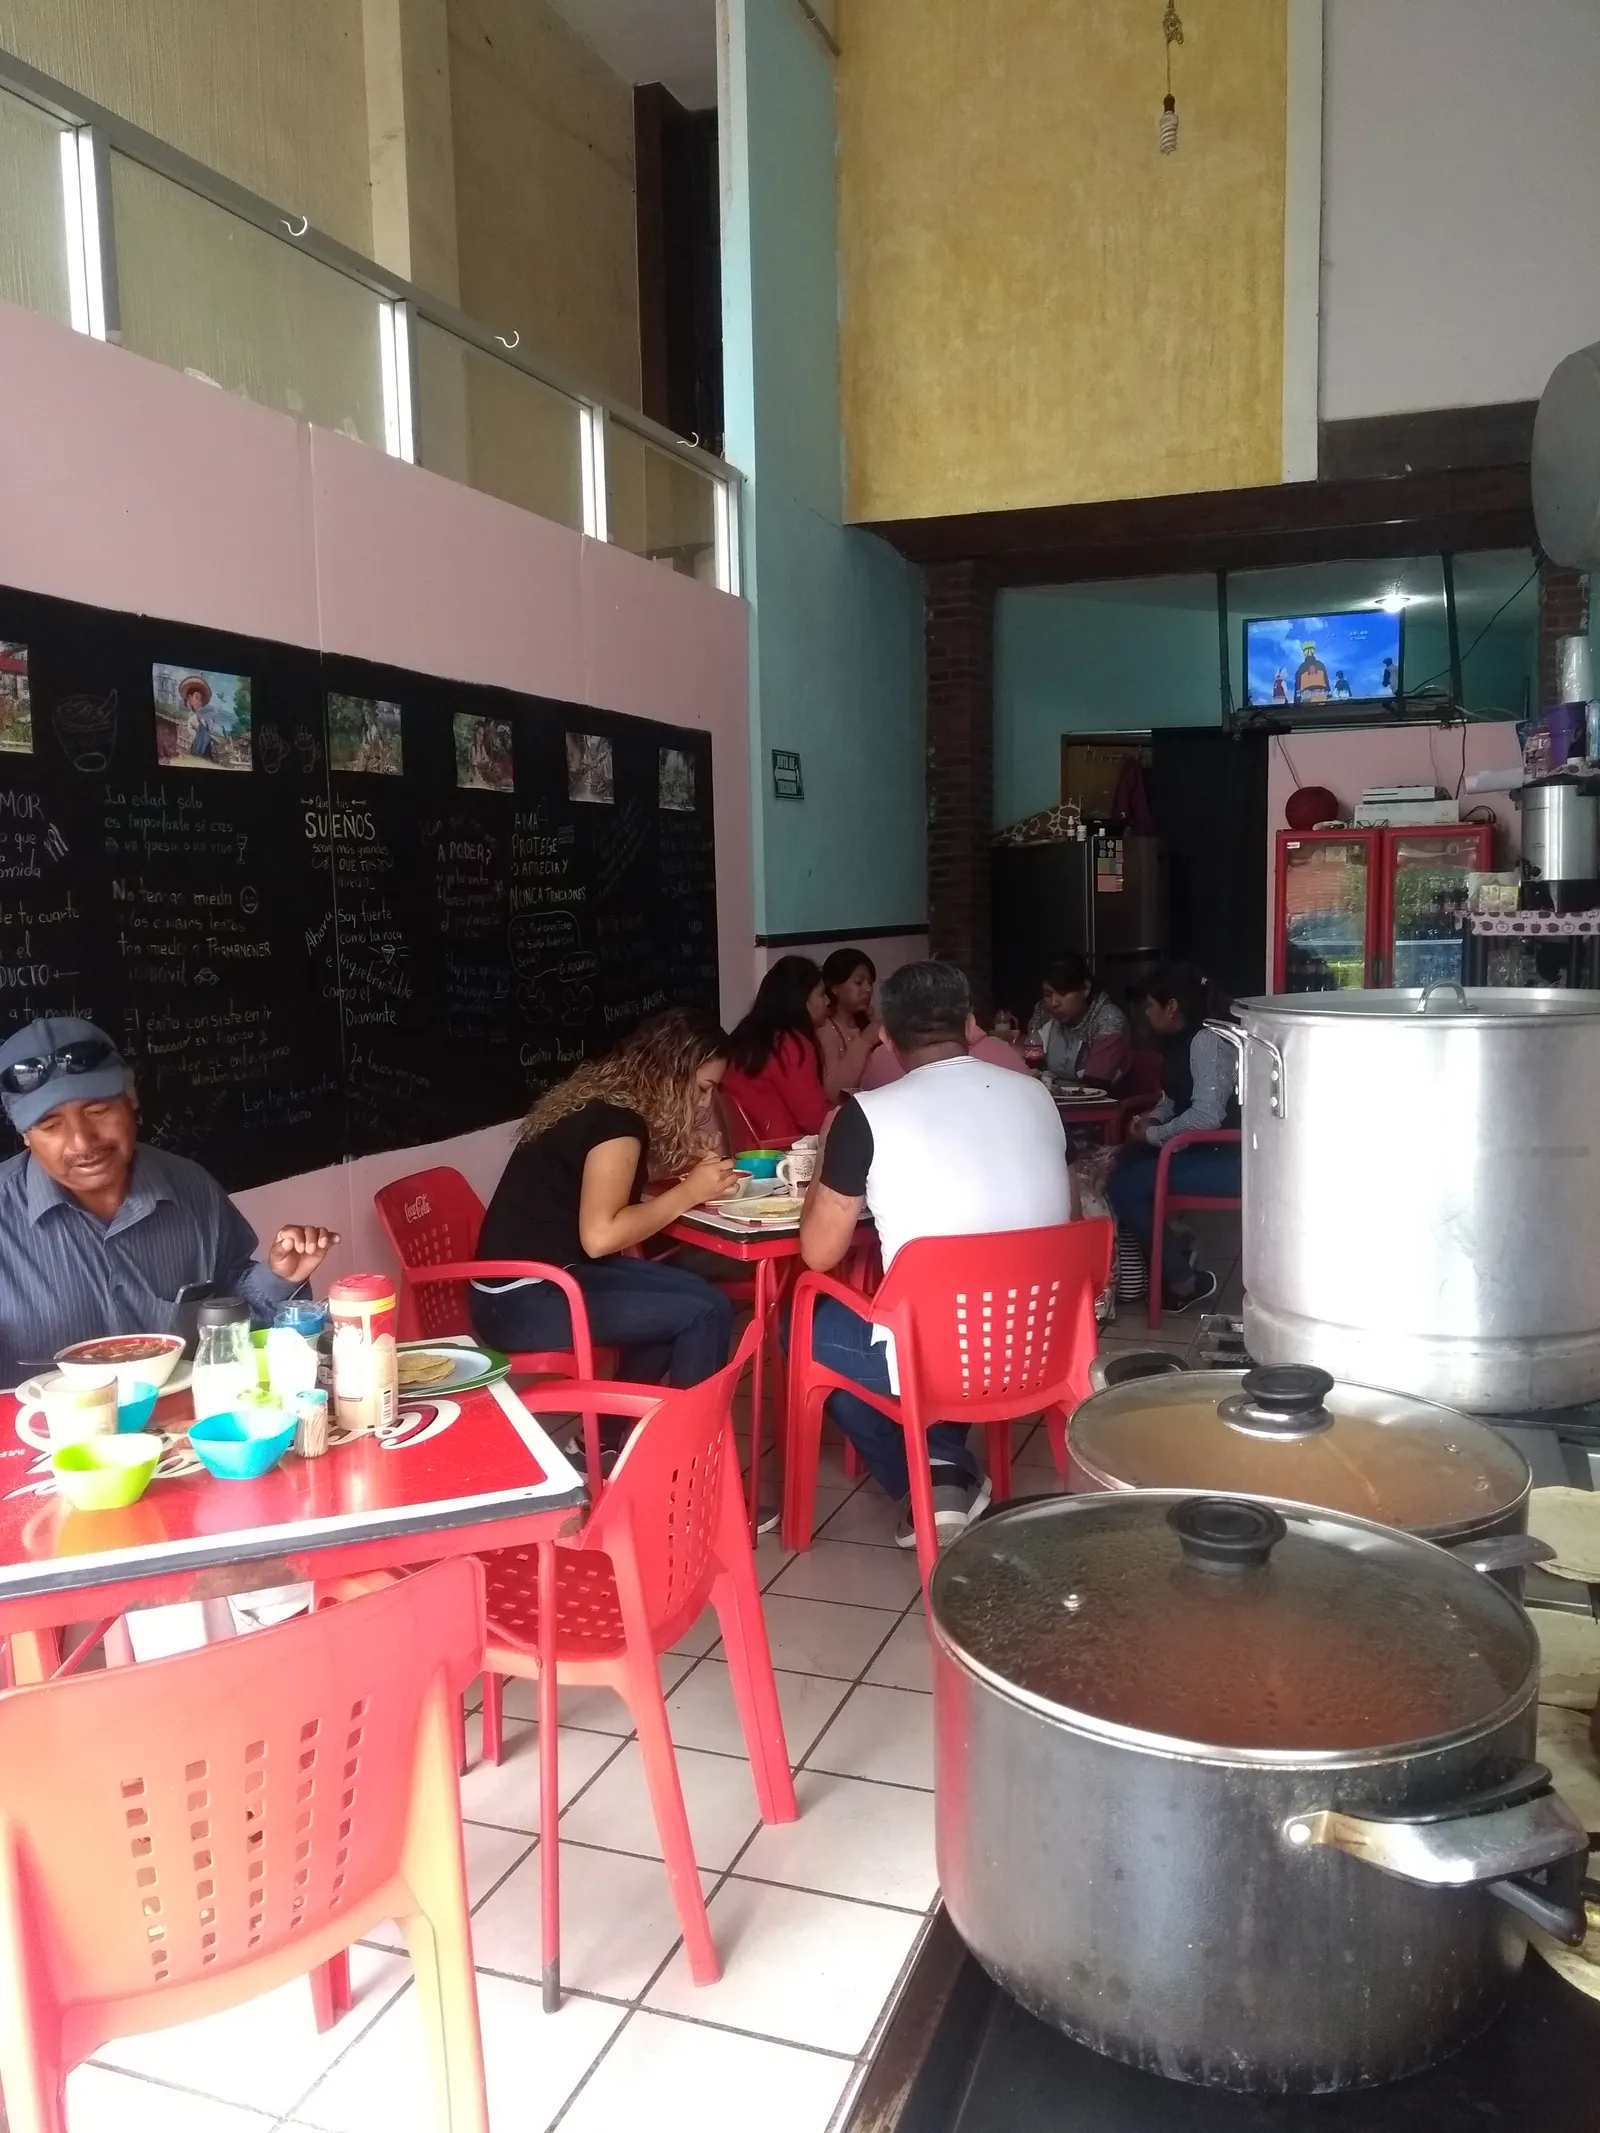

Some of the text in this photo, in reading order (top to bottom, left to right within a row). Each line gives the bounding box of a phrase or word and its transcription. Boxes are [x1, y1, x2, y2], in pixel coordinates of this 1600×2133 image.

[132, 779, 168, 807] edad
[336, 792, 349, 808] tus
[105, 810, 233, 841] es importante si eres
[305, 809, 376, 841] SUEÑOS
[514, 812, 539, 831] AMA
[15, 833, 36, 852] que
[144, 840, 177, 861] queso
[357, 839, 390, 858] grandes
[438, 844, 447, 862] A
[512, 833, 558, 858] PROTEGE
[339, 858, 377, 872] QUE TUS
[112, 878, 135, 902] No
[193, 883, 233, 905] miedo
[509, 885, 543, 913] NUNCA
[18, 901, 33, 924] tu
[39, 890, 80, 923] cuarto
[338, 898, 393, 929] Soy fuerte
[17, 930, 31, 958] el
[304, 911, 333, 955] Ahora
[339, 925, 403, 945] como la roca
[322, 983, 357, 1001] como
[45, 996, 93, 1020] madre
[147, 1003, 180, 1031] éxito
[345, 1001, 397, 1027] Diamante
[405, 1194, 431, 1223] Coca-Cola
